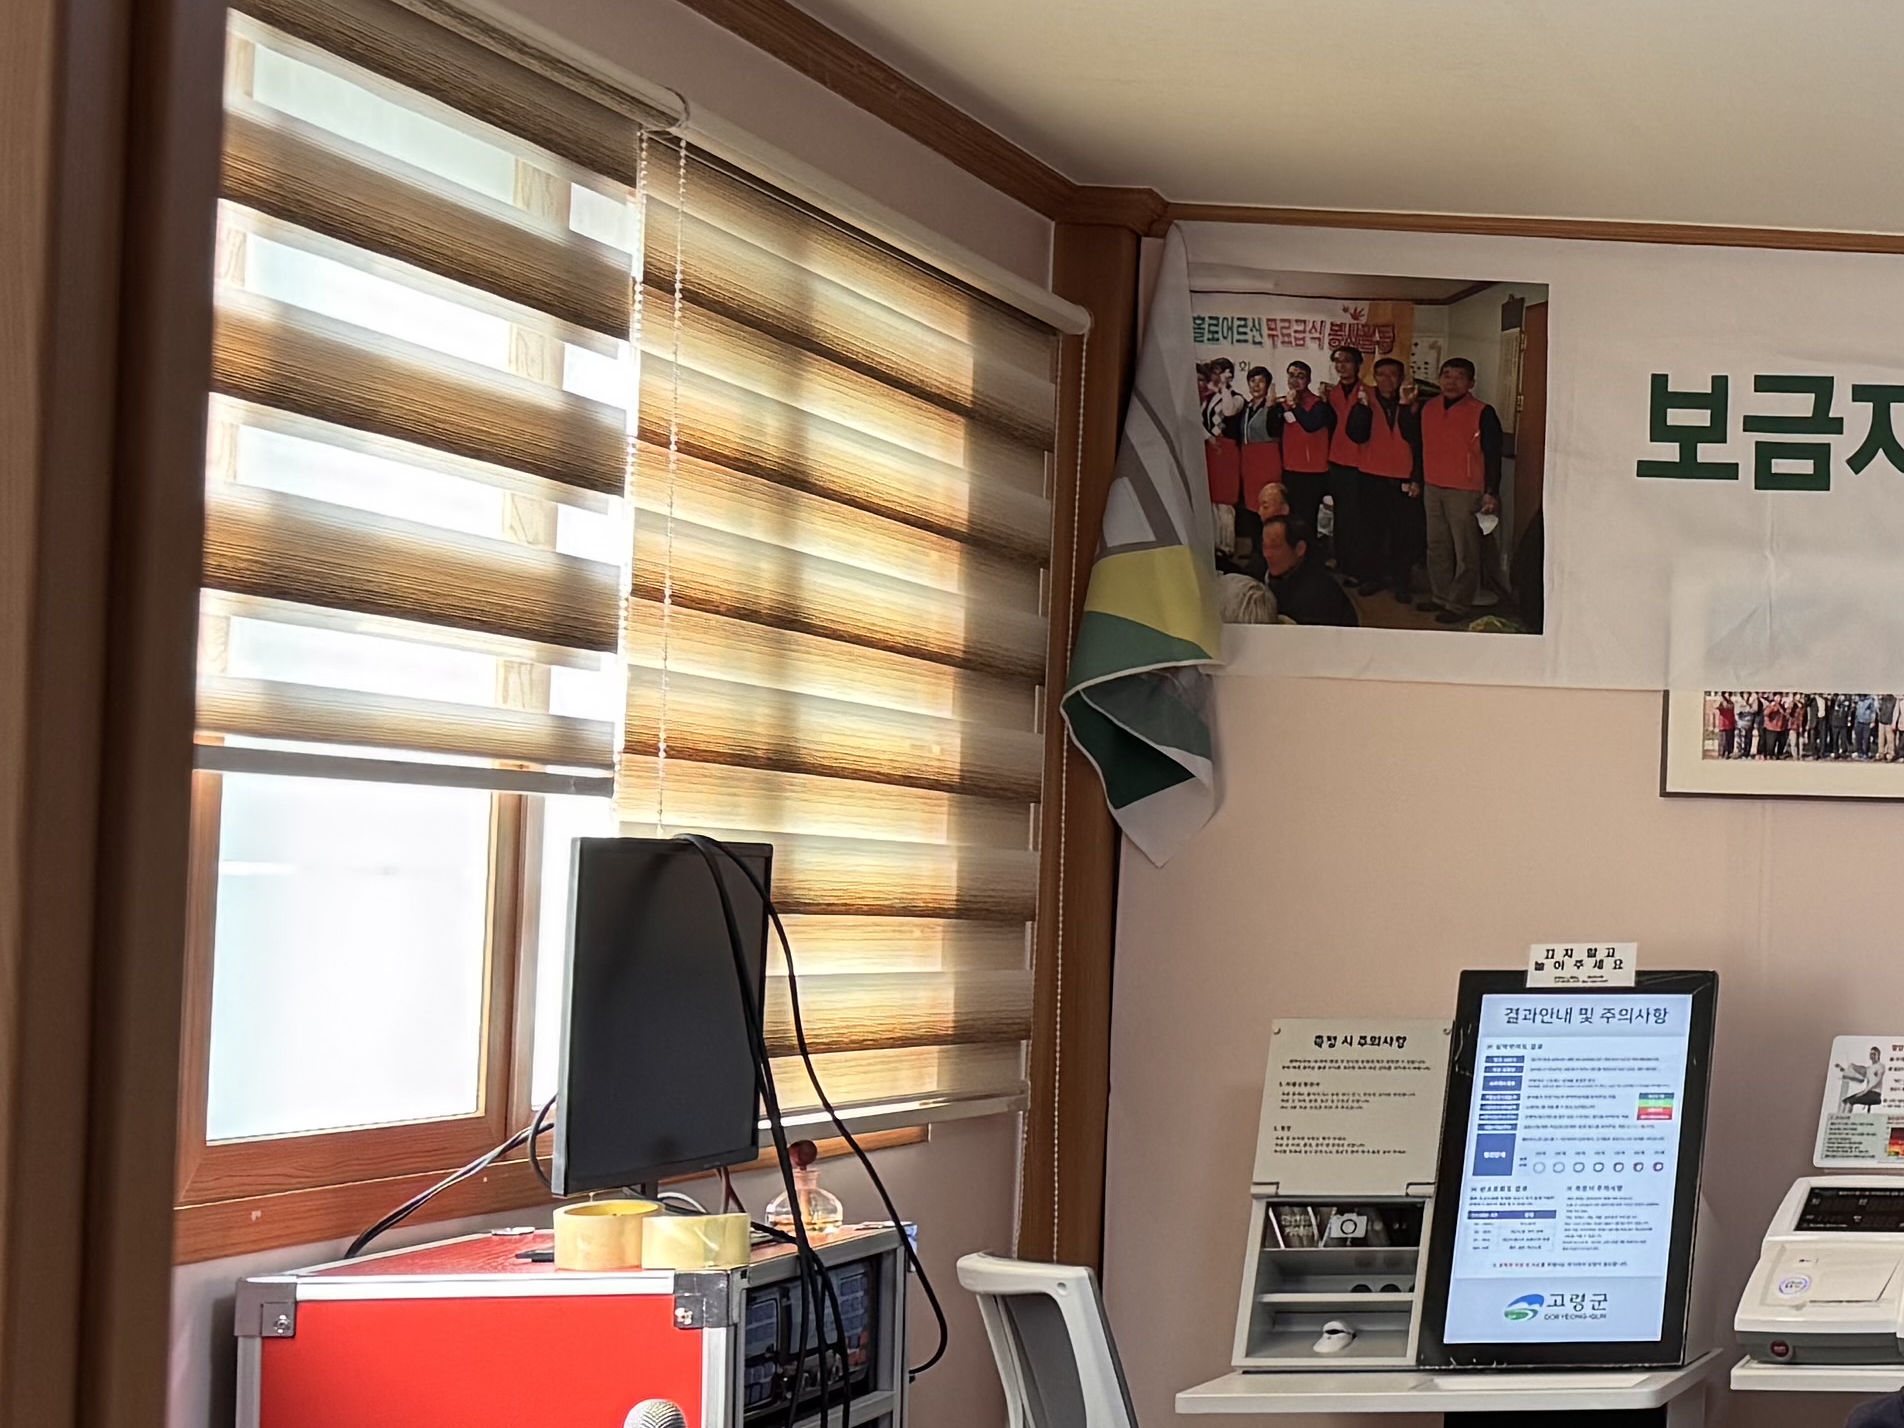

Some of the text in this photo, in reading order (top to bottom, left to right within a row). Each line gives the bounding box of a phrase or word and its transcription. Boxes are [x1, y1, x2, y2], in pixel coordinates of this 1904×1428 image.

[1504, 1007, 1669, 1025] 결과안내 및 주의사항
[1546, 1293, 1608, 1311] 고령군
